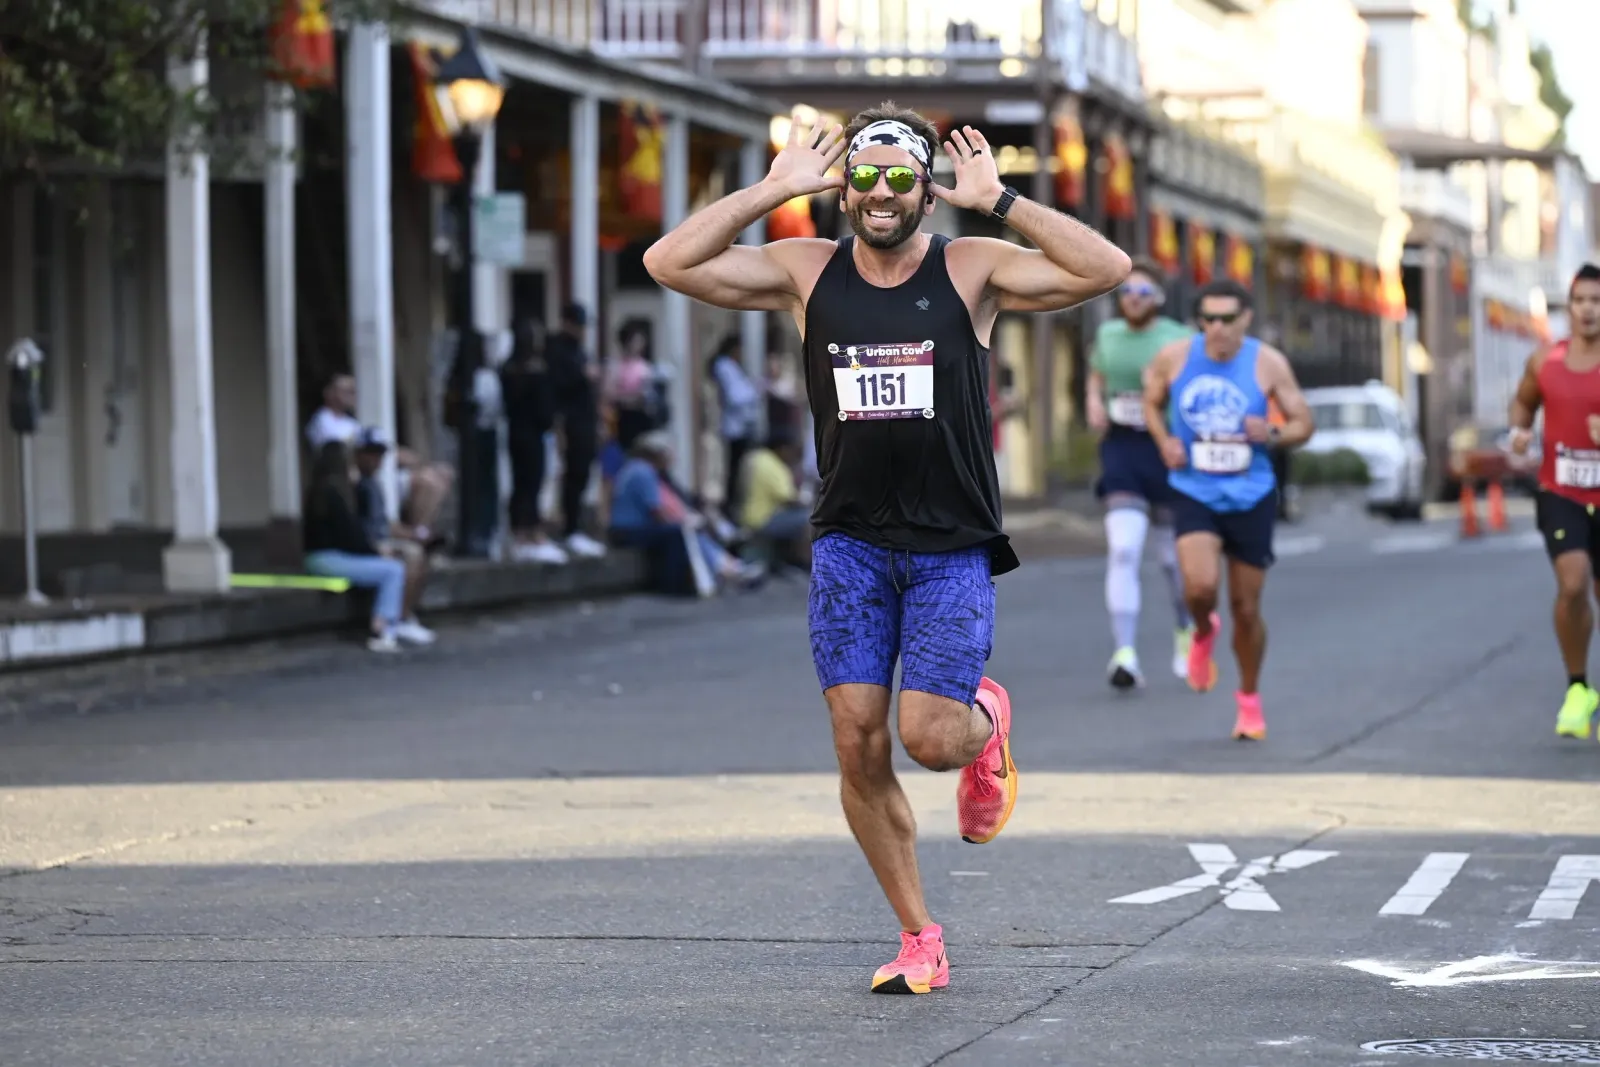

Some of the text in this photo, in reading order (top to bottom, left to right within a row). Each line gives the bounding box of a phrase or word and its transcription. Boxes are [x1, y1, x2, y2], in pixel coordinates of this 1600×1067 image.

[867, 346, 924, 357] Urban Cow
[877, 355, 918, 366] Half Marathon
[856, 372, 906, 407] 1151
